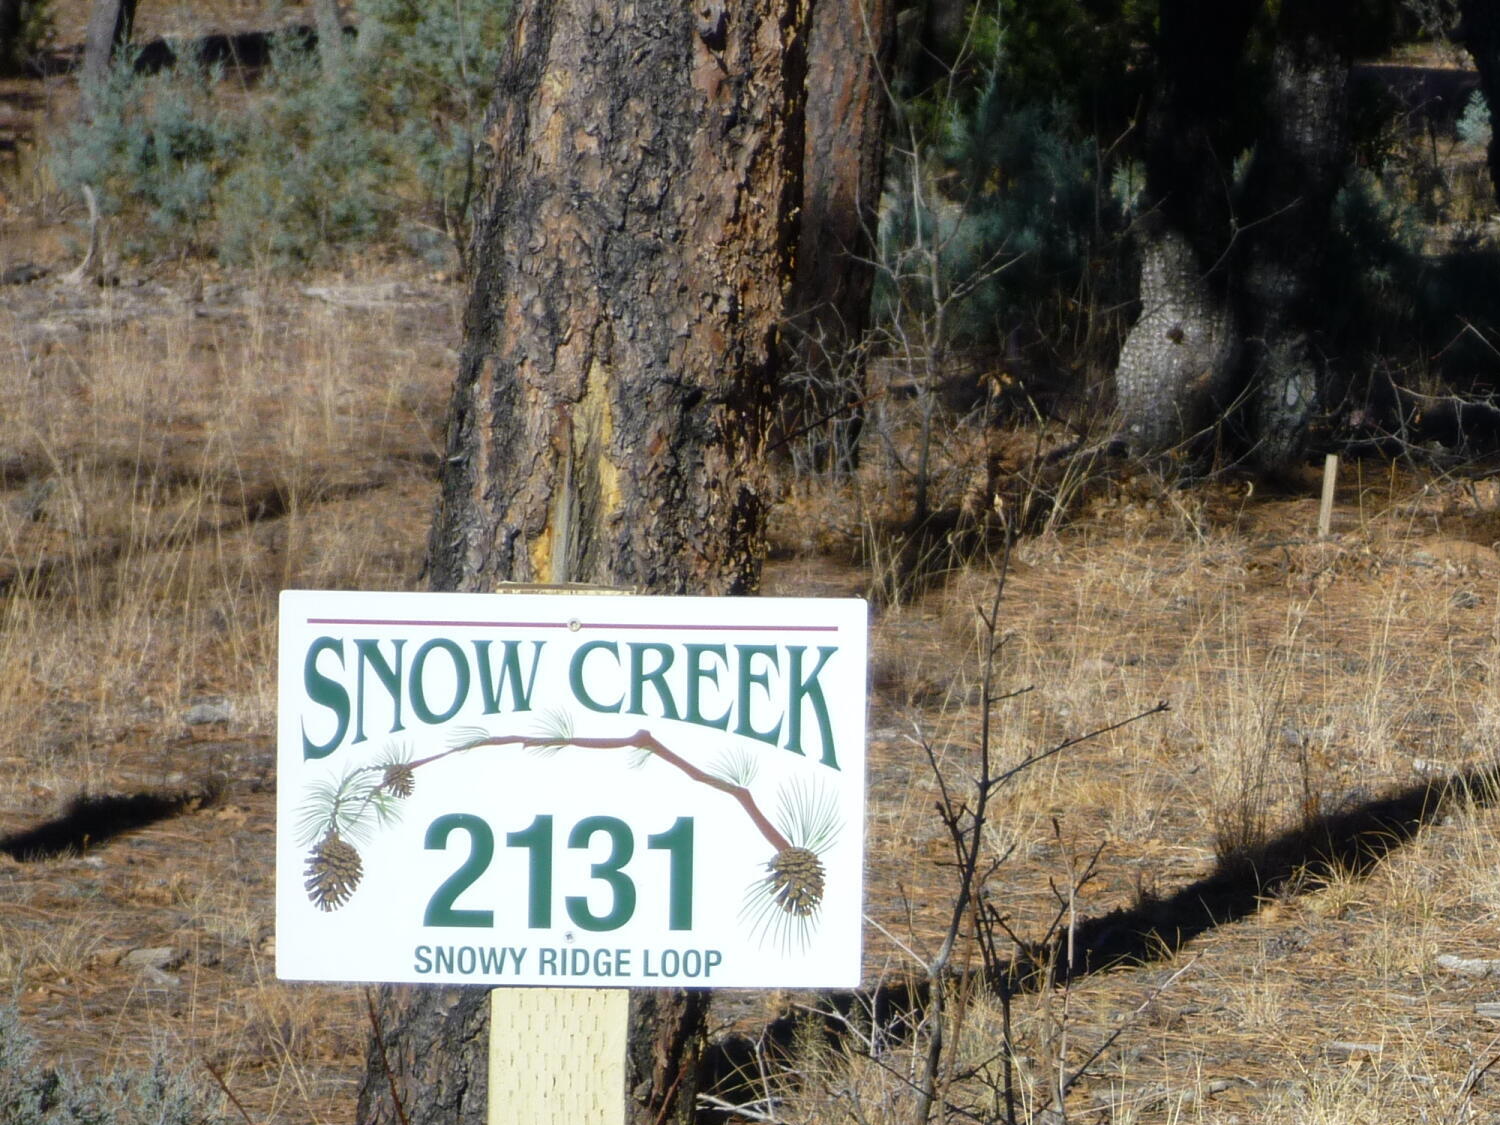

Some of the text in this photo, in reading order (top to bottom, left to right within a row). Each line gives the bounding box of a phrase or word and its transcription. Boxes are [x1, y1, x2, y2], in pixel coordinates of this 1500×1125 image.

[300, 636, 842, 772] SNOW CREEK
[422, 812, 695, 932] 2131
[413, 945, 723, 979] SNOWY RIDGE LOOP
